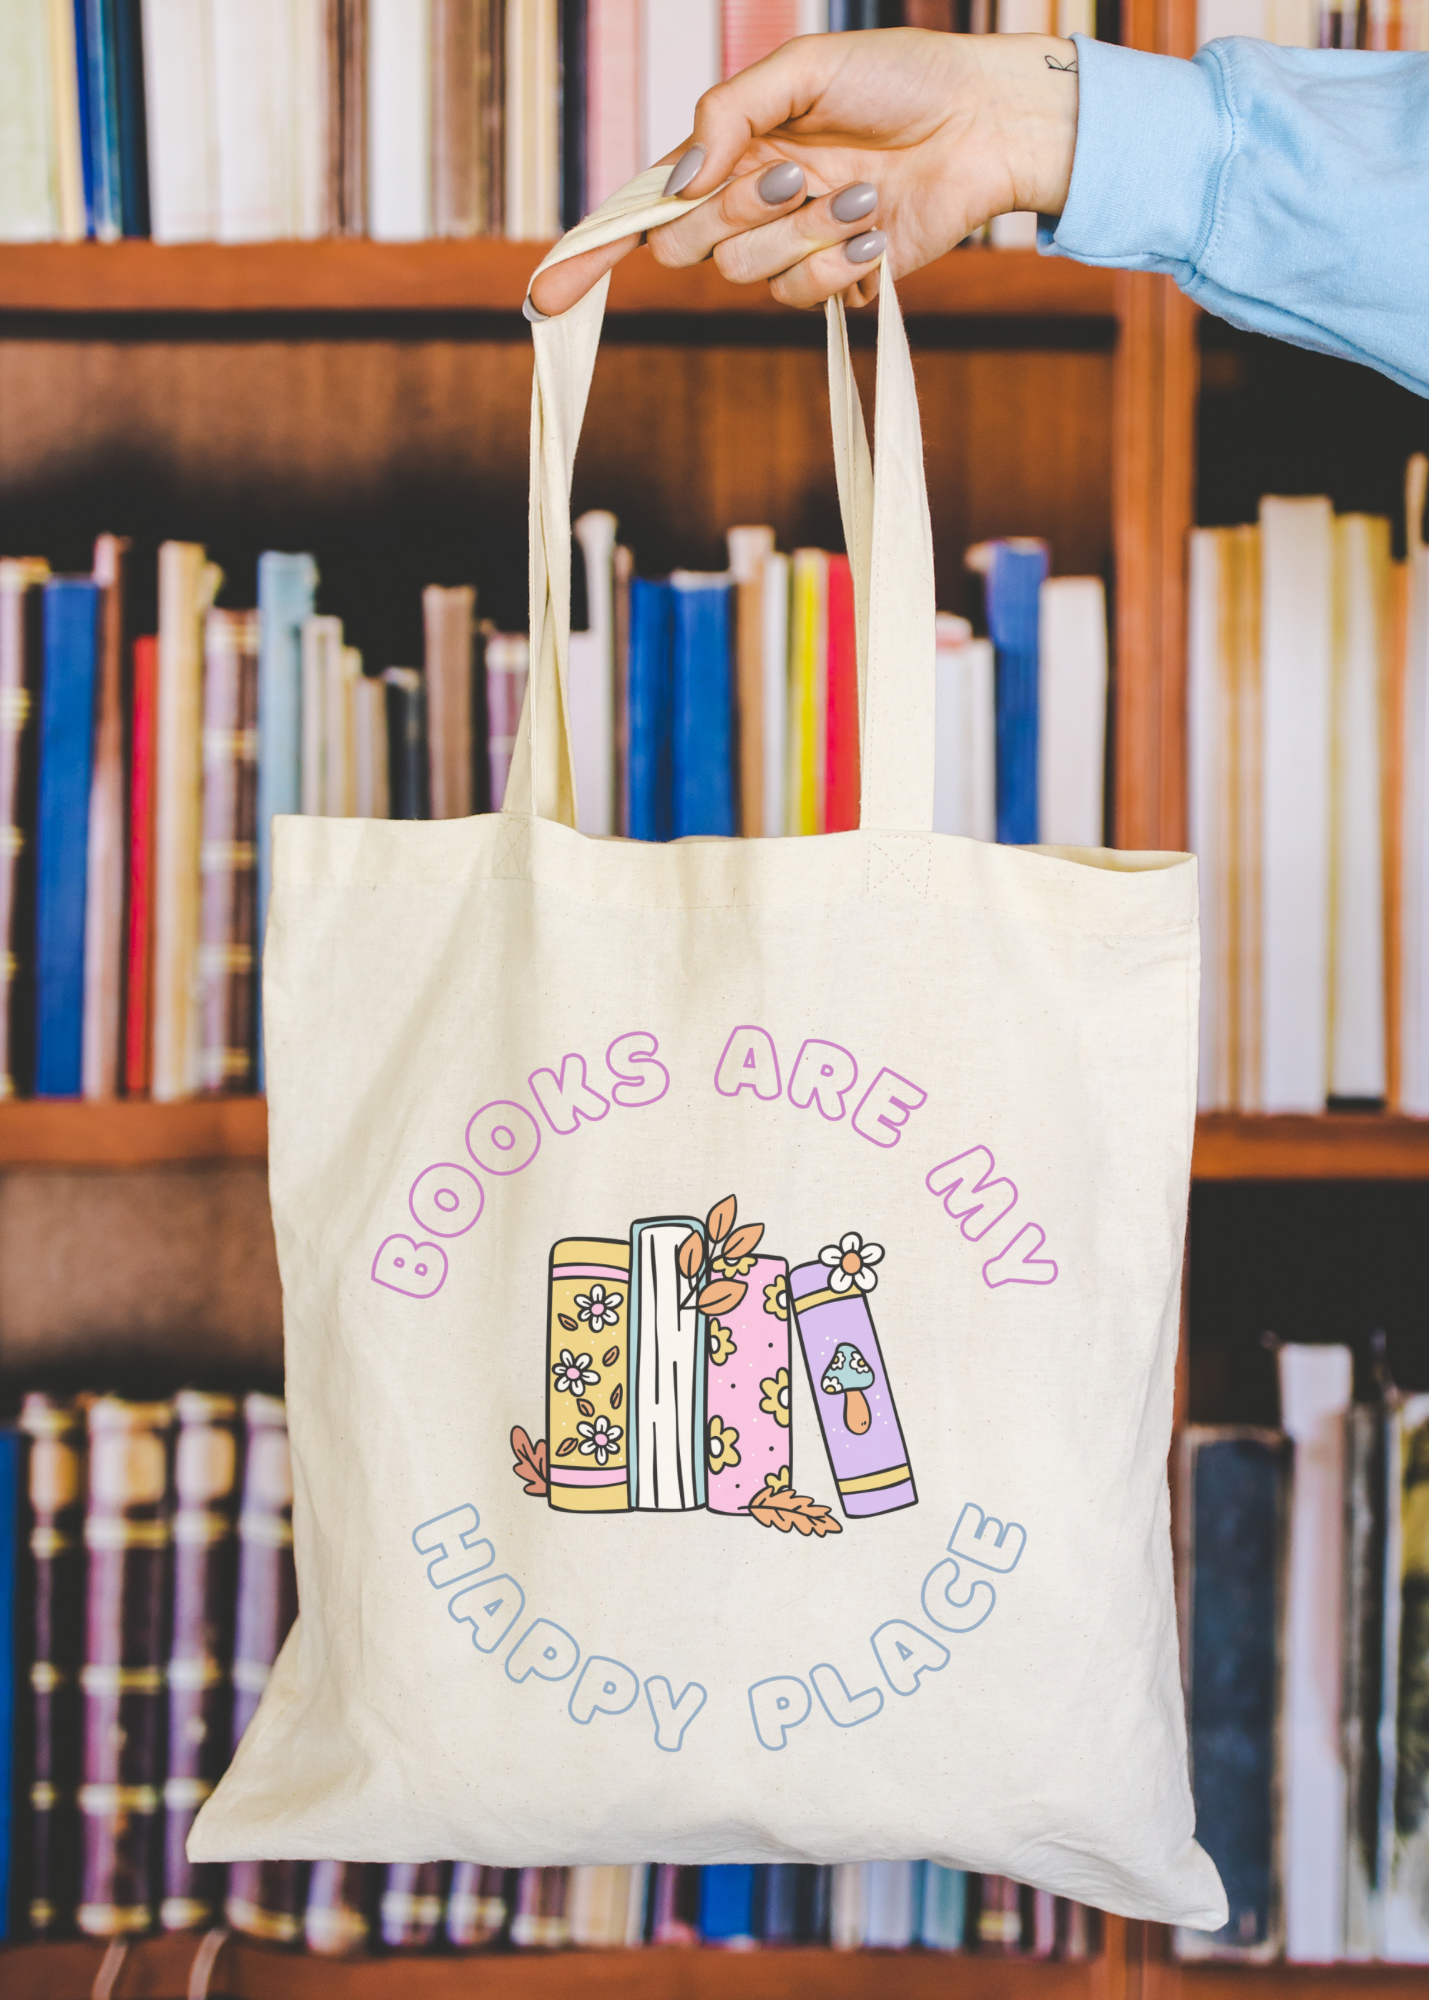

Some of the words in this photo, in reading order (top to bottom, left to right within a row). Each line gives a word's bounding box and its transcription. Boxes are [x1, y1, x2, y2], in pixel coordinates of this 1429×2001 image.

[371, 1030, 671, 1300] BOOKS
[714, 1024, 928, 1149] ARE
[925, 1145, 1059, 1290] MY
[411, 1502, 708, 1753] HAPPY
[747, 1502, 1028, 1752] PLACE
